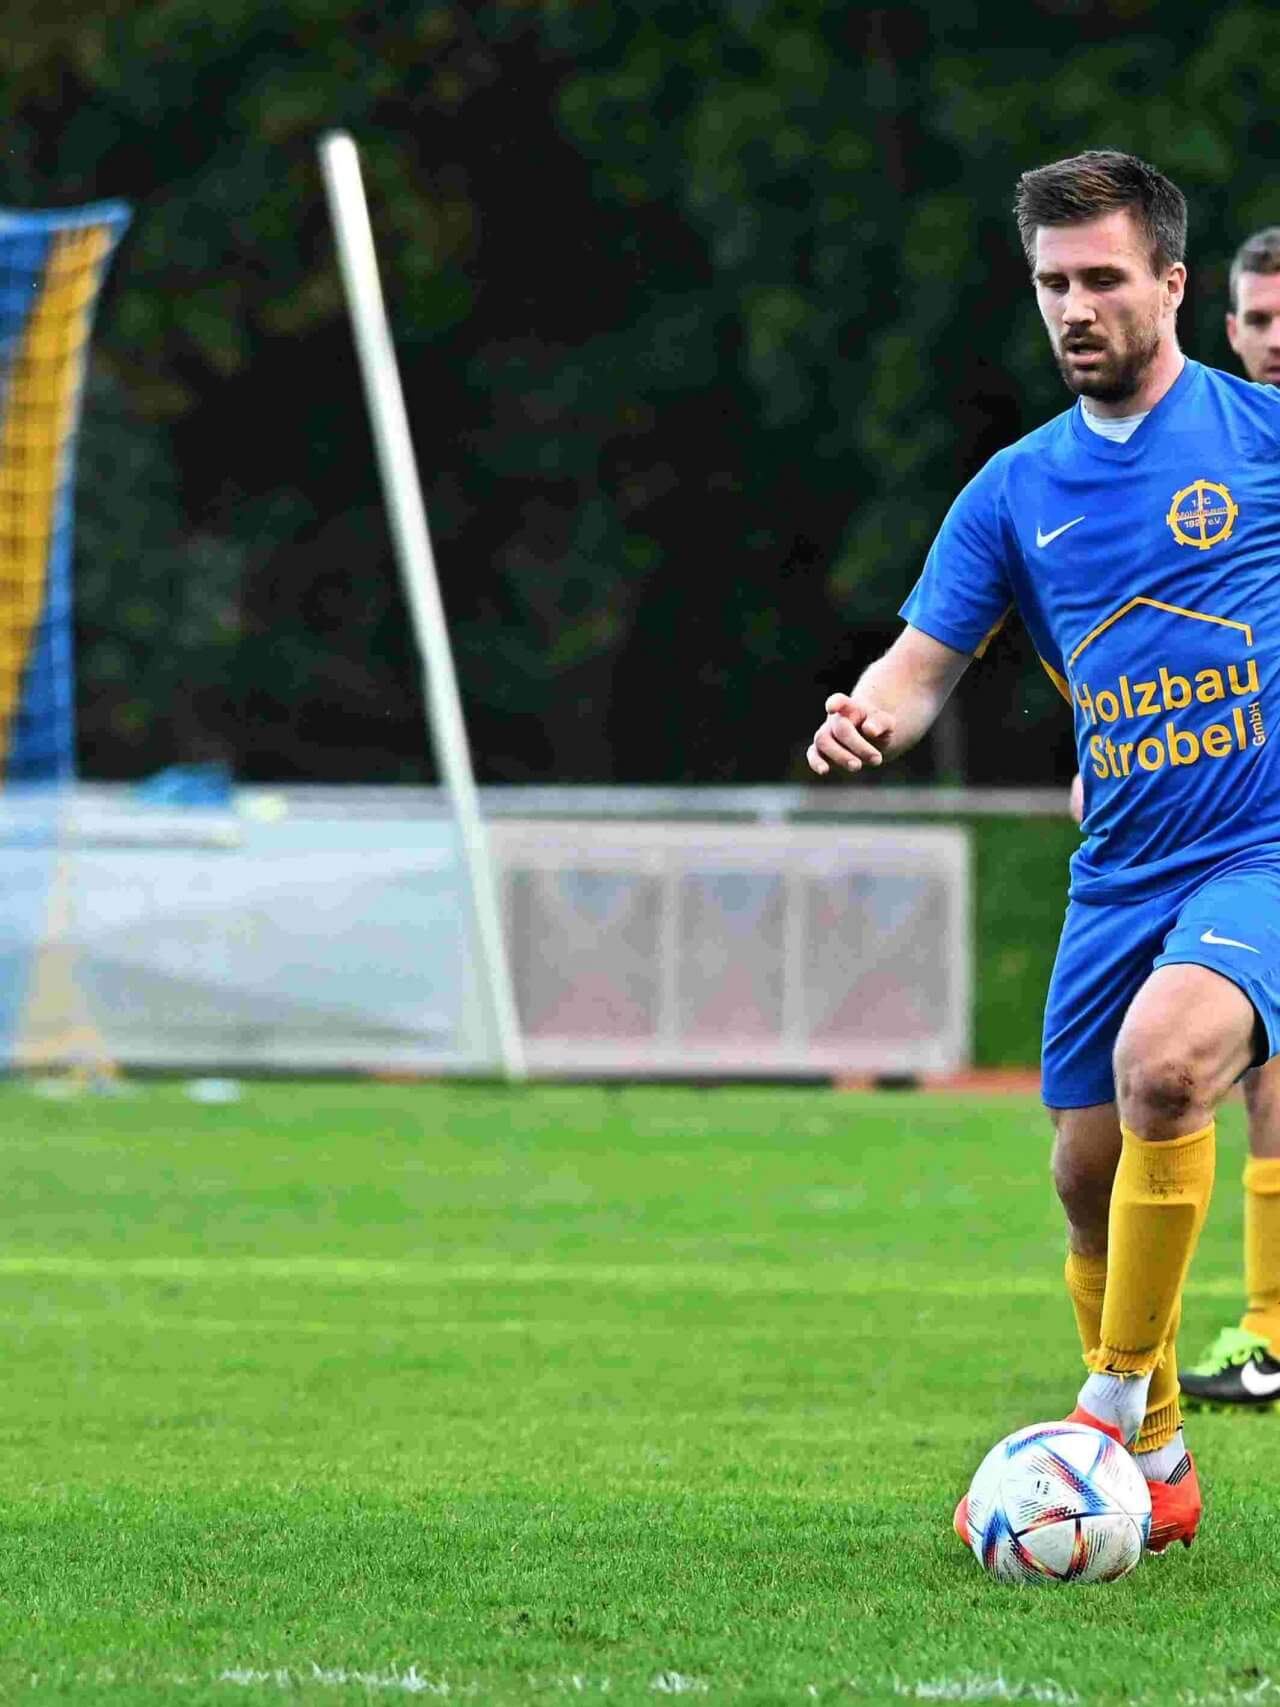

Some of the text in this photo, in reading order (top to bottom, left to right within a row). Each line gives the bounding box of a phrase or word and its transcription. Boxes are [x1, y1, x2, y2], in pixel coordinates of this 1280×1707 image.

[1074, 659, 1260, 726] Holzbau
[1248, 701, 1266, 747] GmbH
[1089, 707, 1248, 780] Strobel
